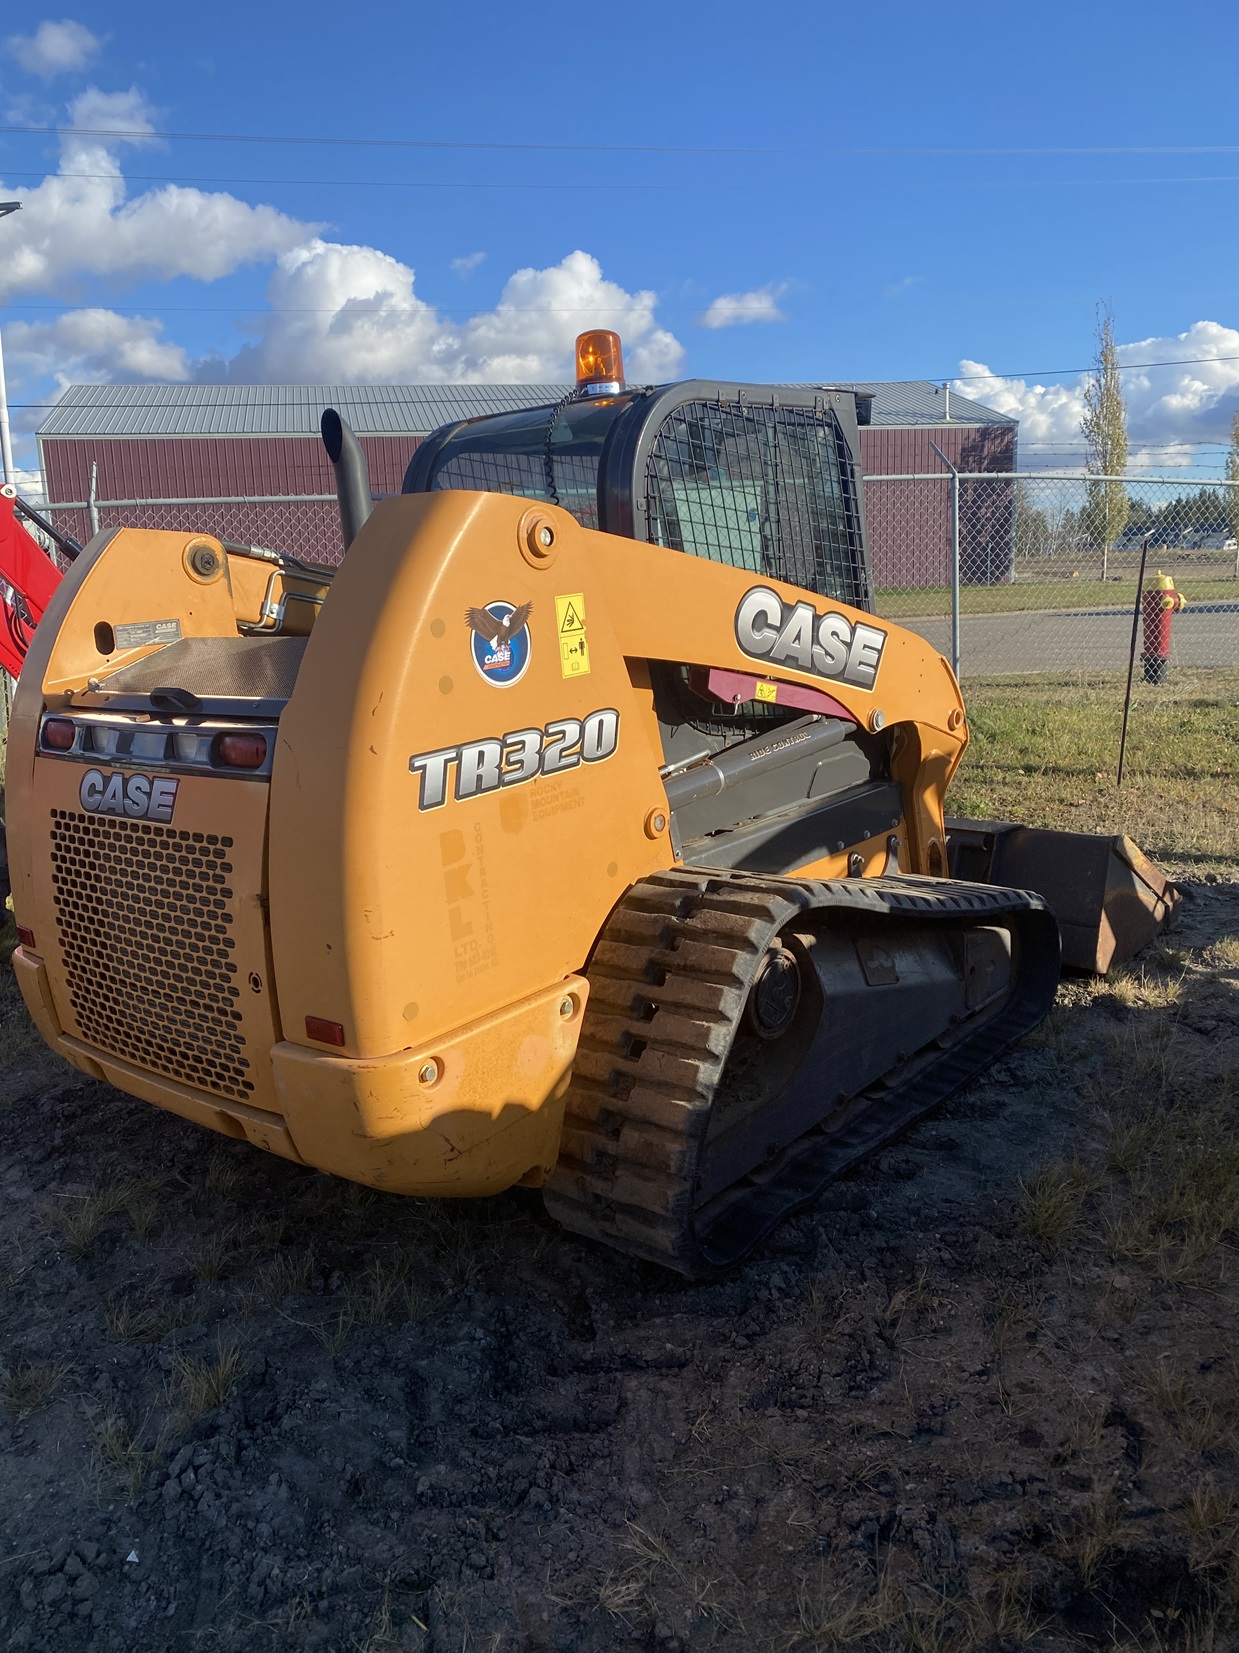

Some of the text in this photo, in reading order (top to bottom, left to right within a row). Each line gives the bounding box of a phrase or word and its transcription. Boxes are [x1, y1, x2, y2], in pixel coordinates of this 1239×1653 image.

[155, 622, 177, 630] CASE
[734, 585, 888, 692] CASE
[484, 651, 511, 664] CASE
[409, 707, 620, 812] TR320
[79, 768, 180, 823] CASE
[530, 780, 563, 798] ROCKY
[531, 786, 580, 810] MOUNTAIN
[532, 796, 586, 821] EQUIPMENT
